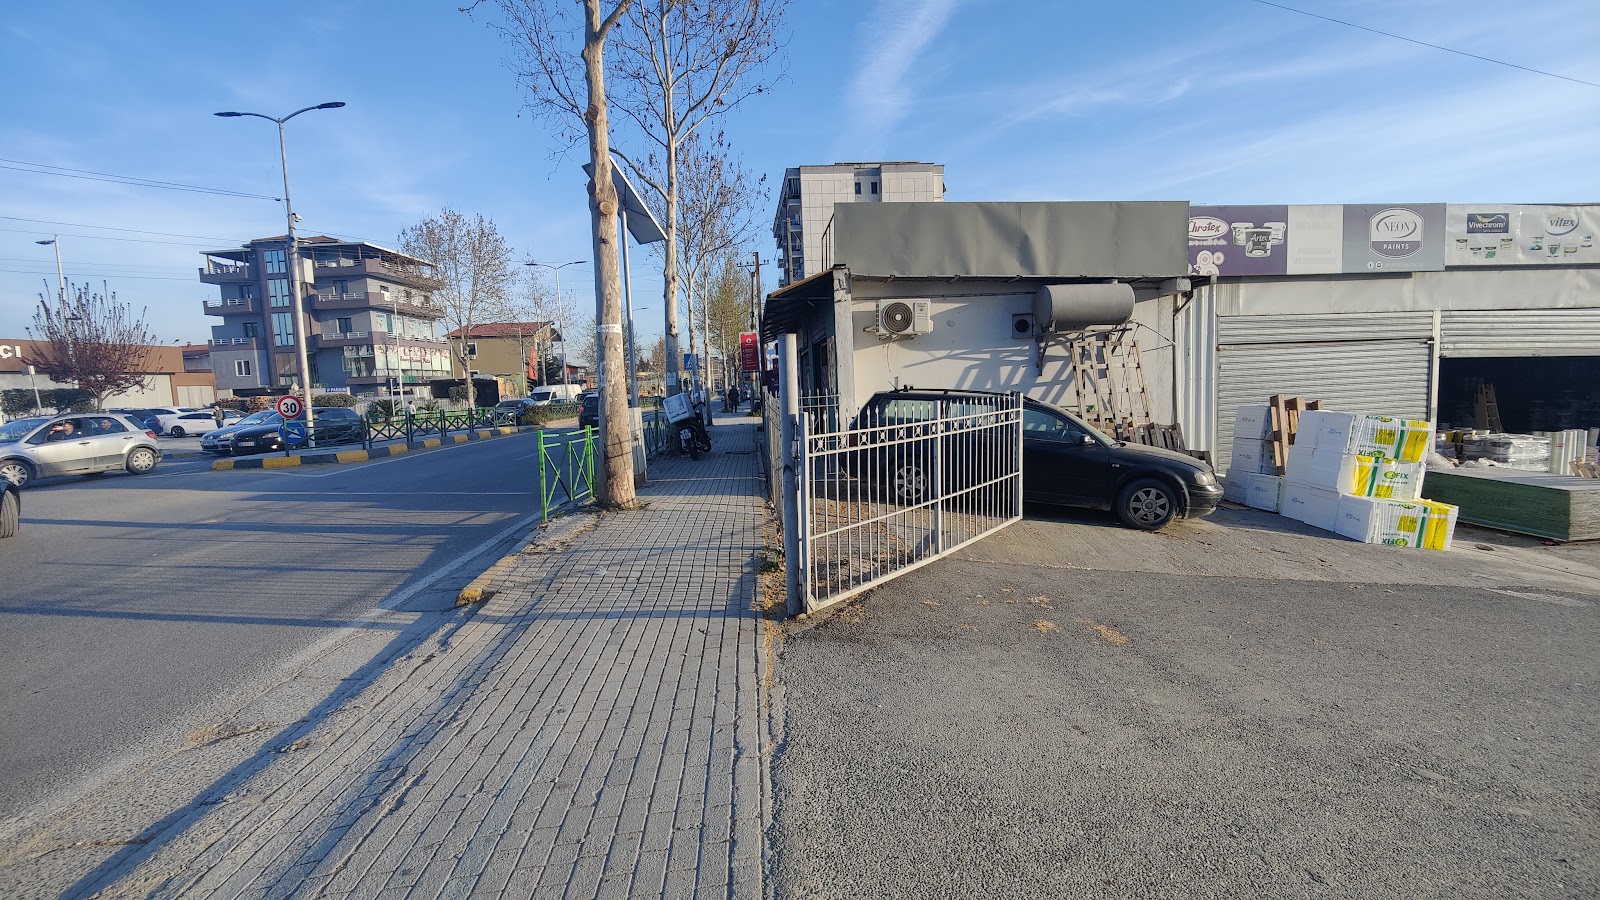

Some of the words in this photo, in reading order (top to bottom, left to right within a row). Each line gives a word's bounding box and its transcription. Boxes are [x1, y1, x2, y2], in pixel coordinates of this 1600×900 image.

[1384, 222, 1410, 231] NEON
[1468, 221, 1504, 229] Vivechrom
[1550, 217, 1575, 227] vitex
[282, 402, 297, 413] 30
